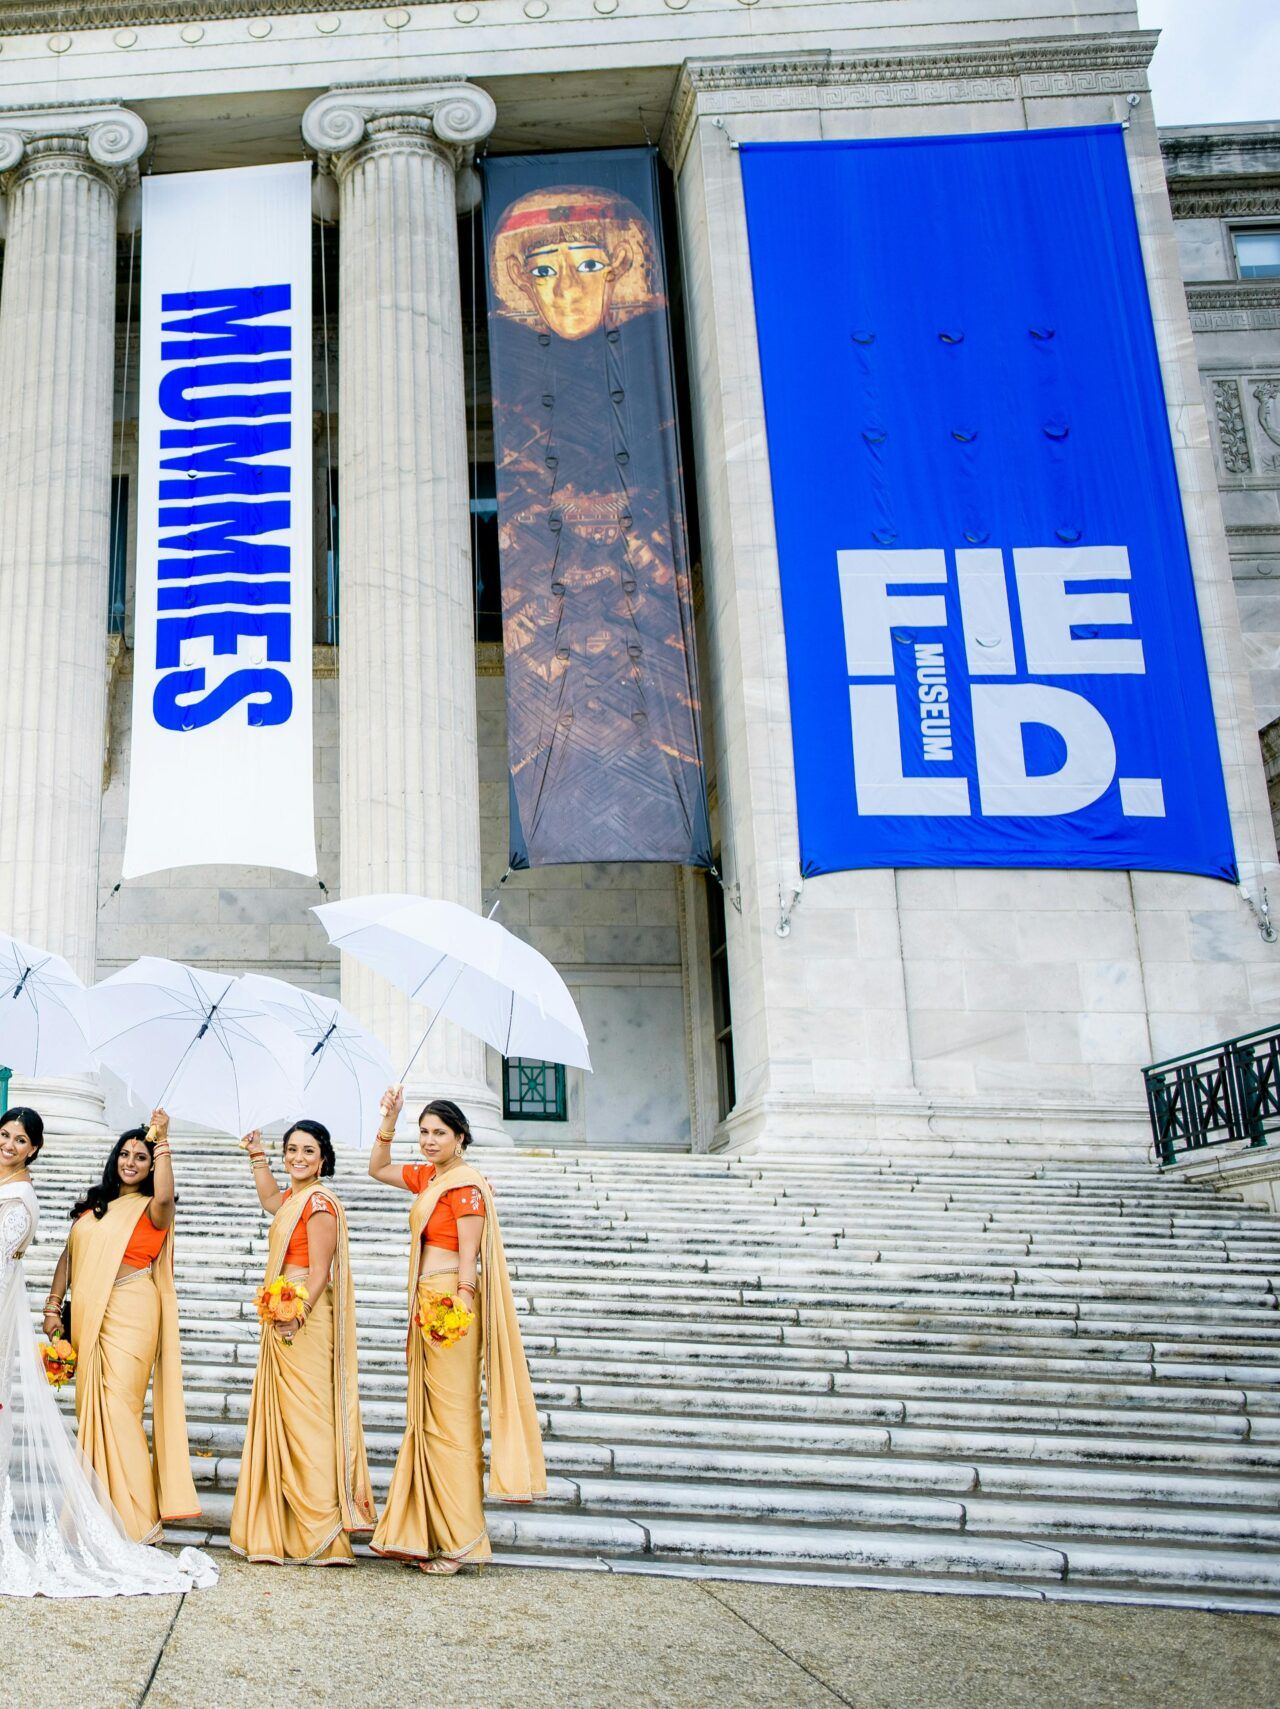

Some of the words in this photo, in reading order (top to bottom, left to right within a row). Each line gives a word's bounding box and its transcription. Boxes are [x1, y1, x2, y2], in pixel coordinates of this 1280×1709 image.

[153, 283, 293, 732] MUMMIES
[836, 545, 1146, 676] FIE
[848, 682, 1166, 817] LD.
[915, 643, 954, 761] MUSEUM
